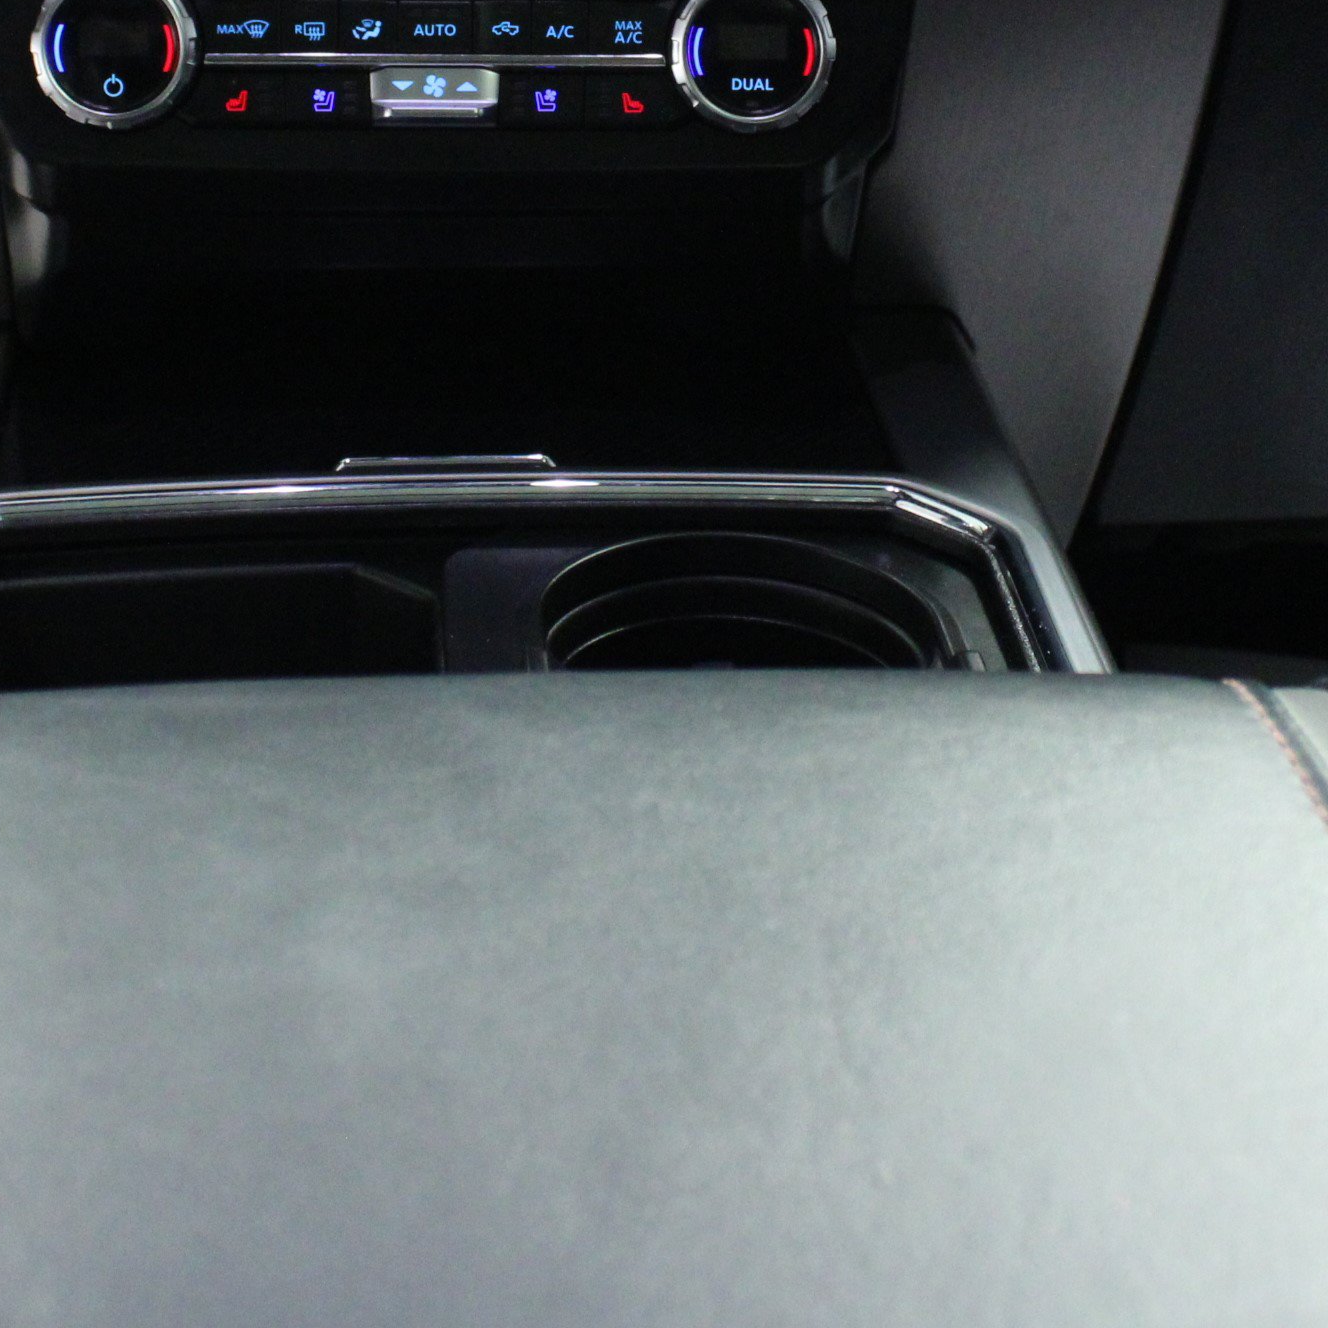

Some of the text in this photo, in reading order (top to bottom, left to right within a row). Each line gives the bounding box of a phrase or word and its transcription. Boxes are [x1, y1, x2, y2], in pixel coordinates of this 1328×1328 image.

[216, 24, 244, 35] MAX
[294, 24, 303, 35] R
[413, 23, 457, 37] AUTO
[545, 24, 575, 40] A/C
[615, 20, 643, 30] MAX
[614, 30, 643, 45] A/C
[730, 77, 774, 93] DUAL
